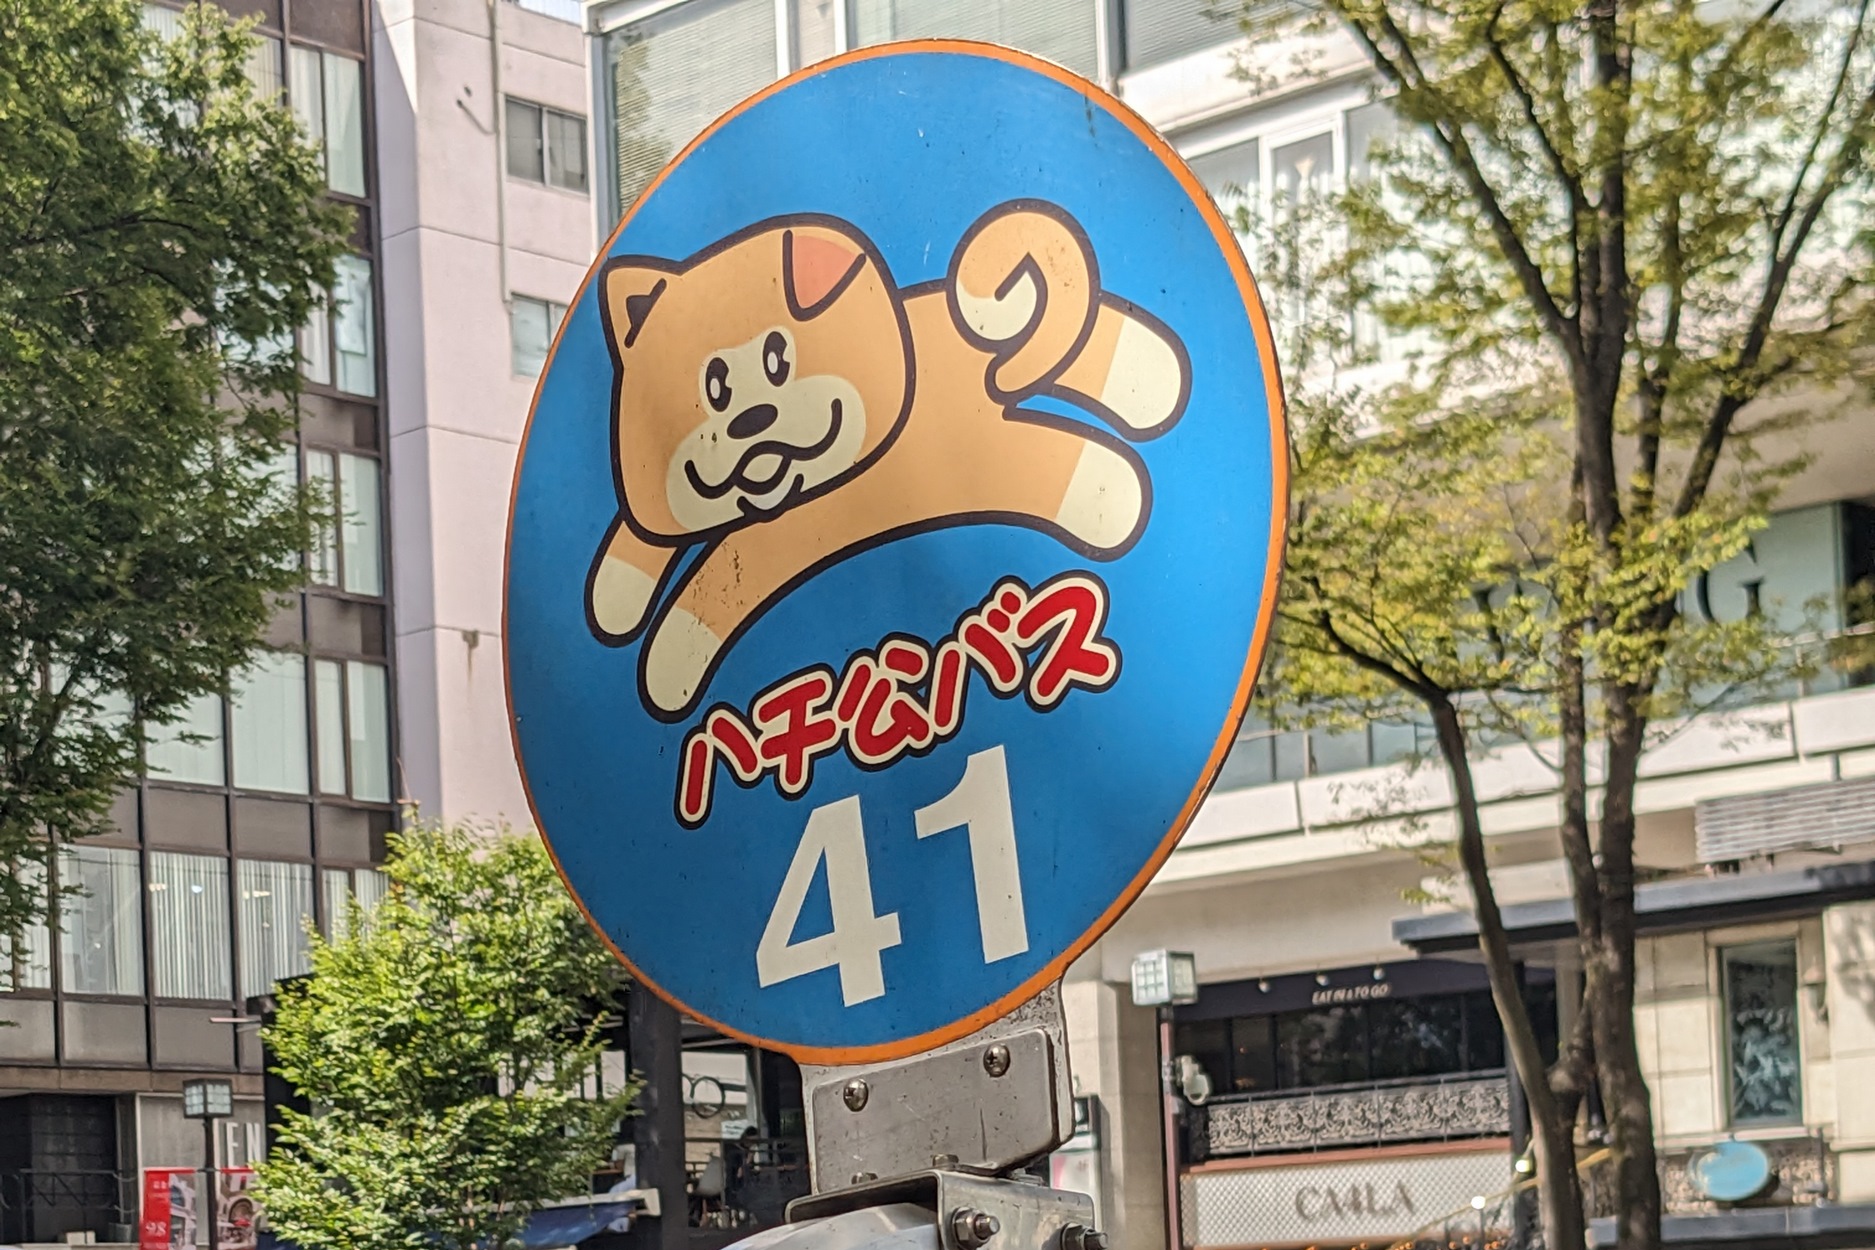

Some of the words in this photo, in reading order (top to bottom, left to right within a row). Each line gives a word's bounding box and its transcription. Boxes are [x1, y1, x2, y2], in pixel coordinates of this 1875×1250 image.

[678, 571, 1122, 830] ハチ公バス
[756, 744, 1029, 1007] 41
